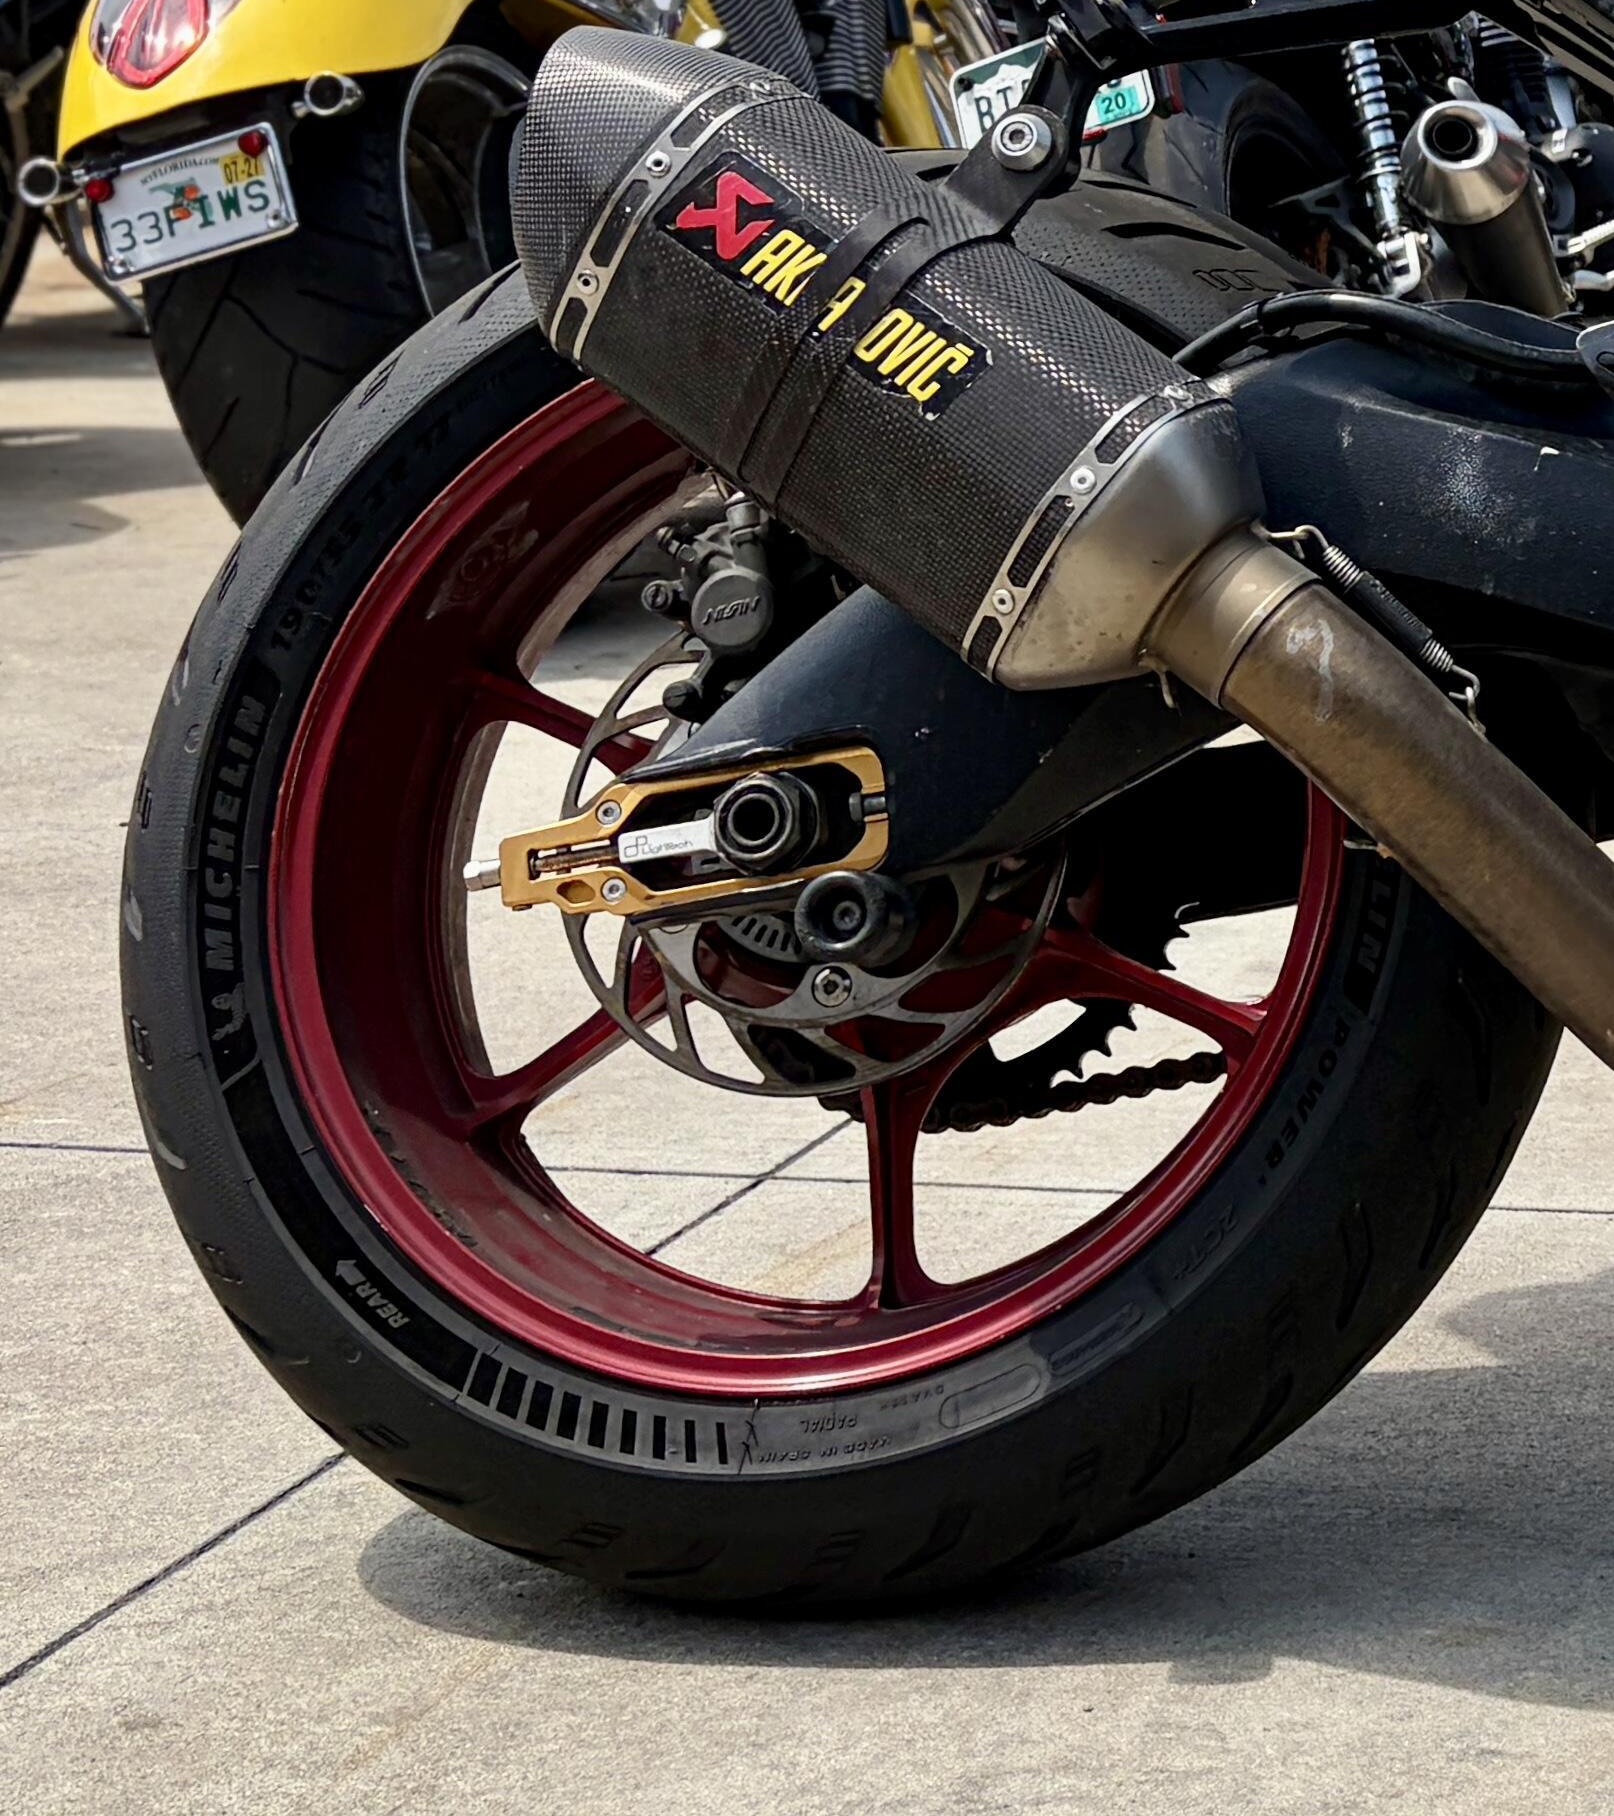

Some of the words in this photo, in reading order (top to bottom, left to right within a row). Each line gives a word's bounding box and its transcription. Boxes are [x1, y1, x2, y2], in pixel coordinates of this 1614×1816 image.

[1101, 92, 1128, 114] 20
[203, 694, 266, 971] MICHELIN
[1263, 1016, 1351, 1171] POWER
[351, 1277, 411, 1333] REAR
